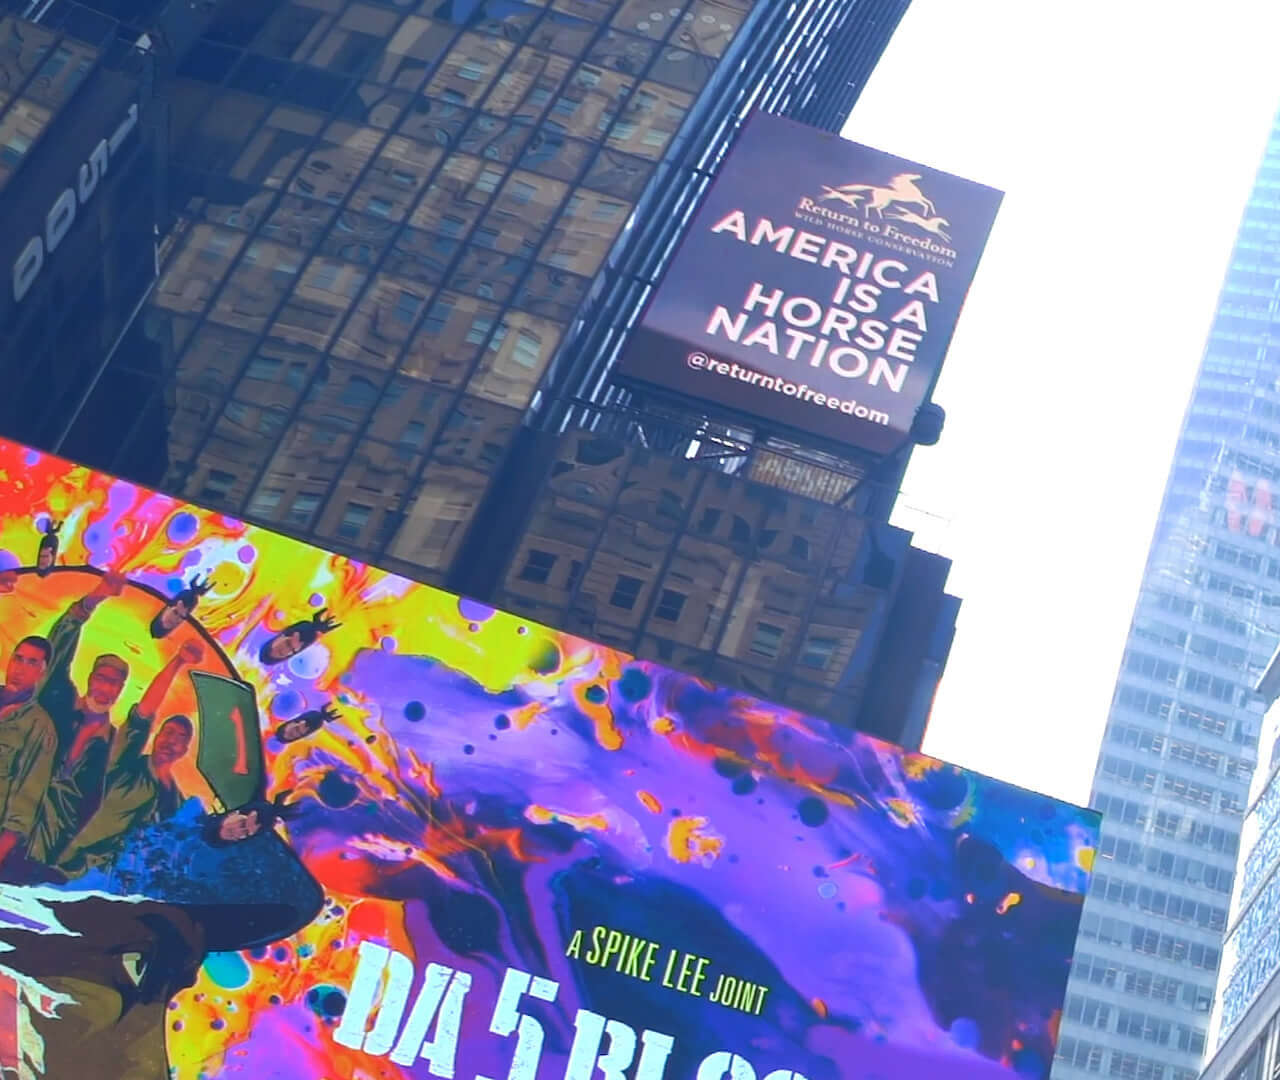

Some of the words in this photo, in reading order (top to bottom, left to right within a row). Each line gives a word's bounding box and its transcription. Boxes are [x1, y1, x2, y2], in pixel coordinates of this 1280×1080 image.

[711, 210, 940, 303] AMERICA
[799, 197, 859, 228] Return
[864, 217, 881, 234] to
[883, 223, 957, 259] Freedom
[743, 282, 923, 361] HORSE
[832, 277, 883, 313] IS
[891, 300, 927, 332] A
[687, 351, 890, 426] @returntofreedom
[706, 306, 909, 393] NATION
[333, 940, 472, 1078] DA
[567, 929, 583, 960] A
[587, 925, 661, 981] SPIKE
[663, 949, 711, 998] LEE
[709, 972, 768, 1016] JOINT
